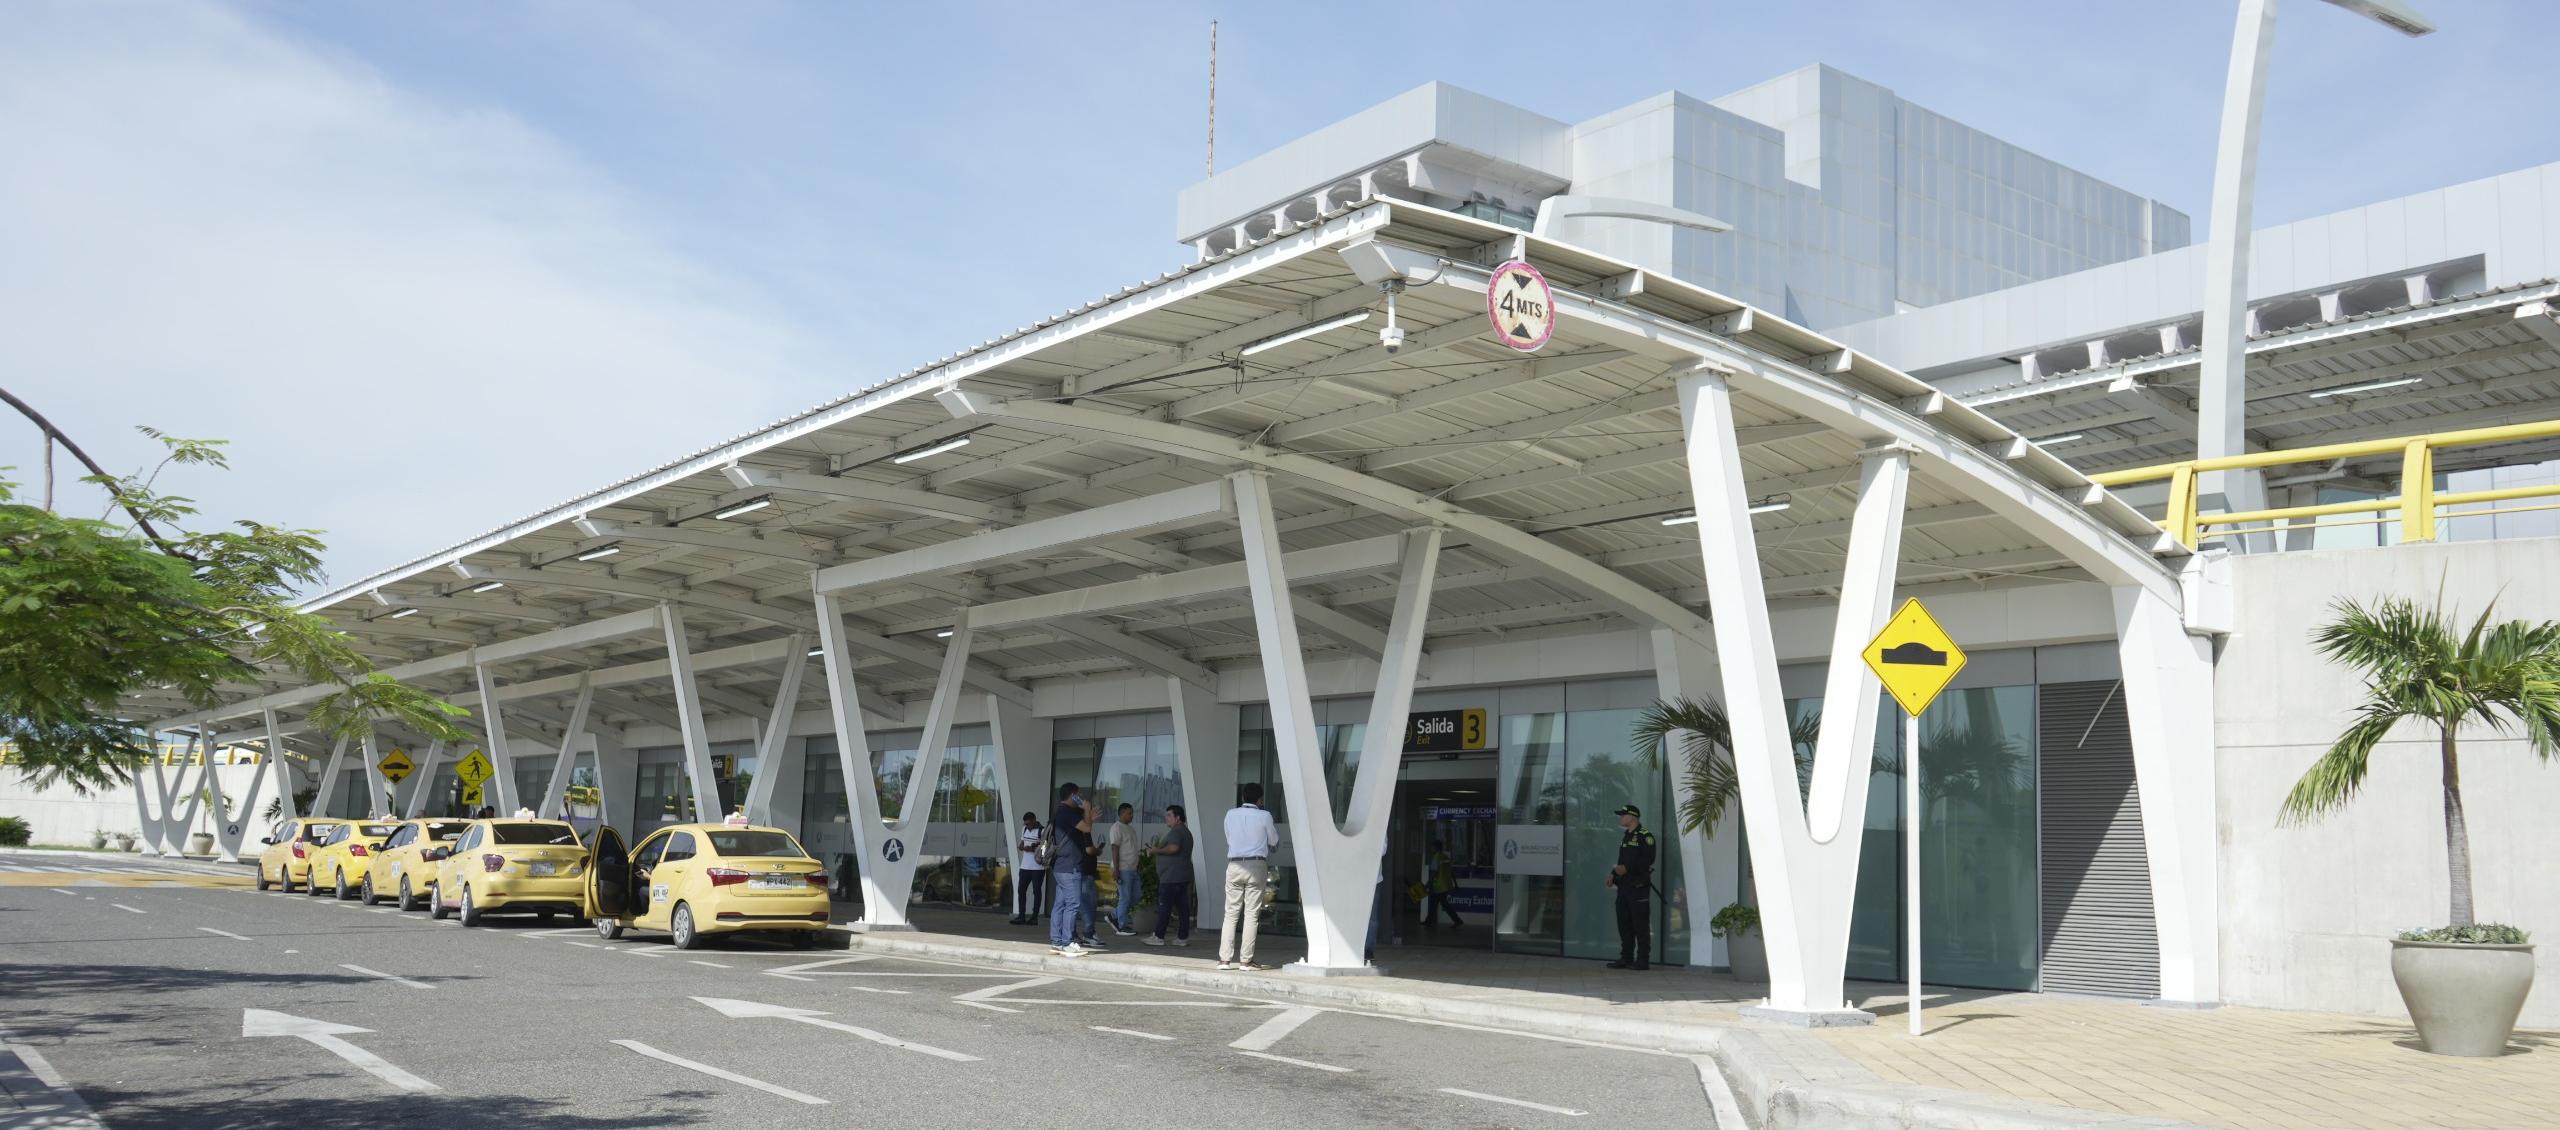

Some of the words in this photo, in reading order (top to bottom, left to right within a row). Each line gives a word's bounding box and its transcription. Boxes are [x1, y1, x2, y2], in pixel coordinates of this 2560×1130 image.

[1500, 290, 1515, 318] 4
[1517, 298, 1543, 318] MTS
[1417, 717, 1454, 735] Salida
[1467, 714, 1480, 744] 3
[1417, 735, 1431, 745] Exit
[726, 757, 732, 775] 2
[1439, 807, 1471, 815] CURRENCY
[1446, 894, 1472, 907] Currency
